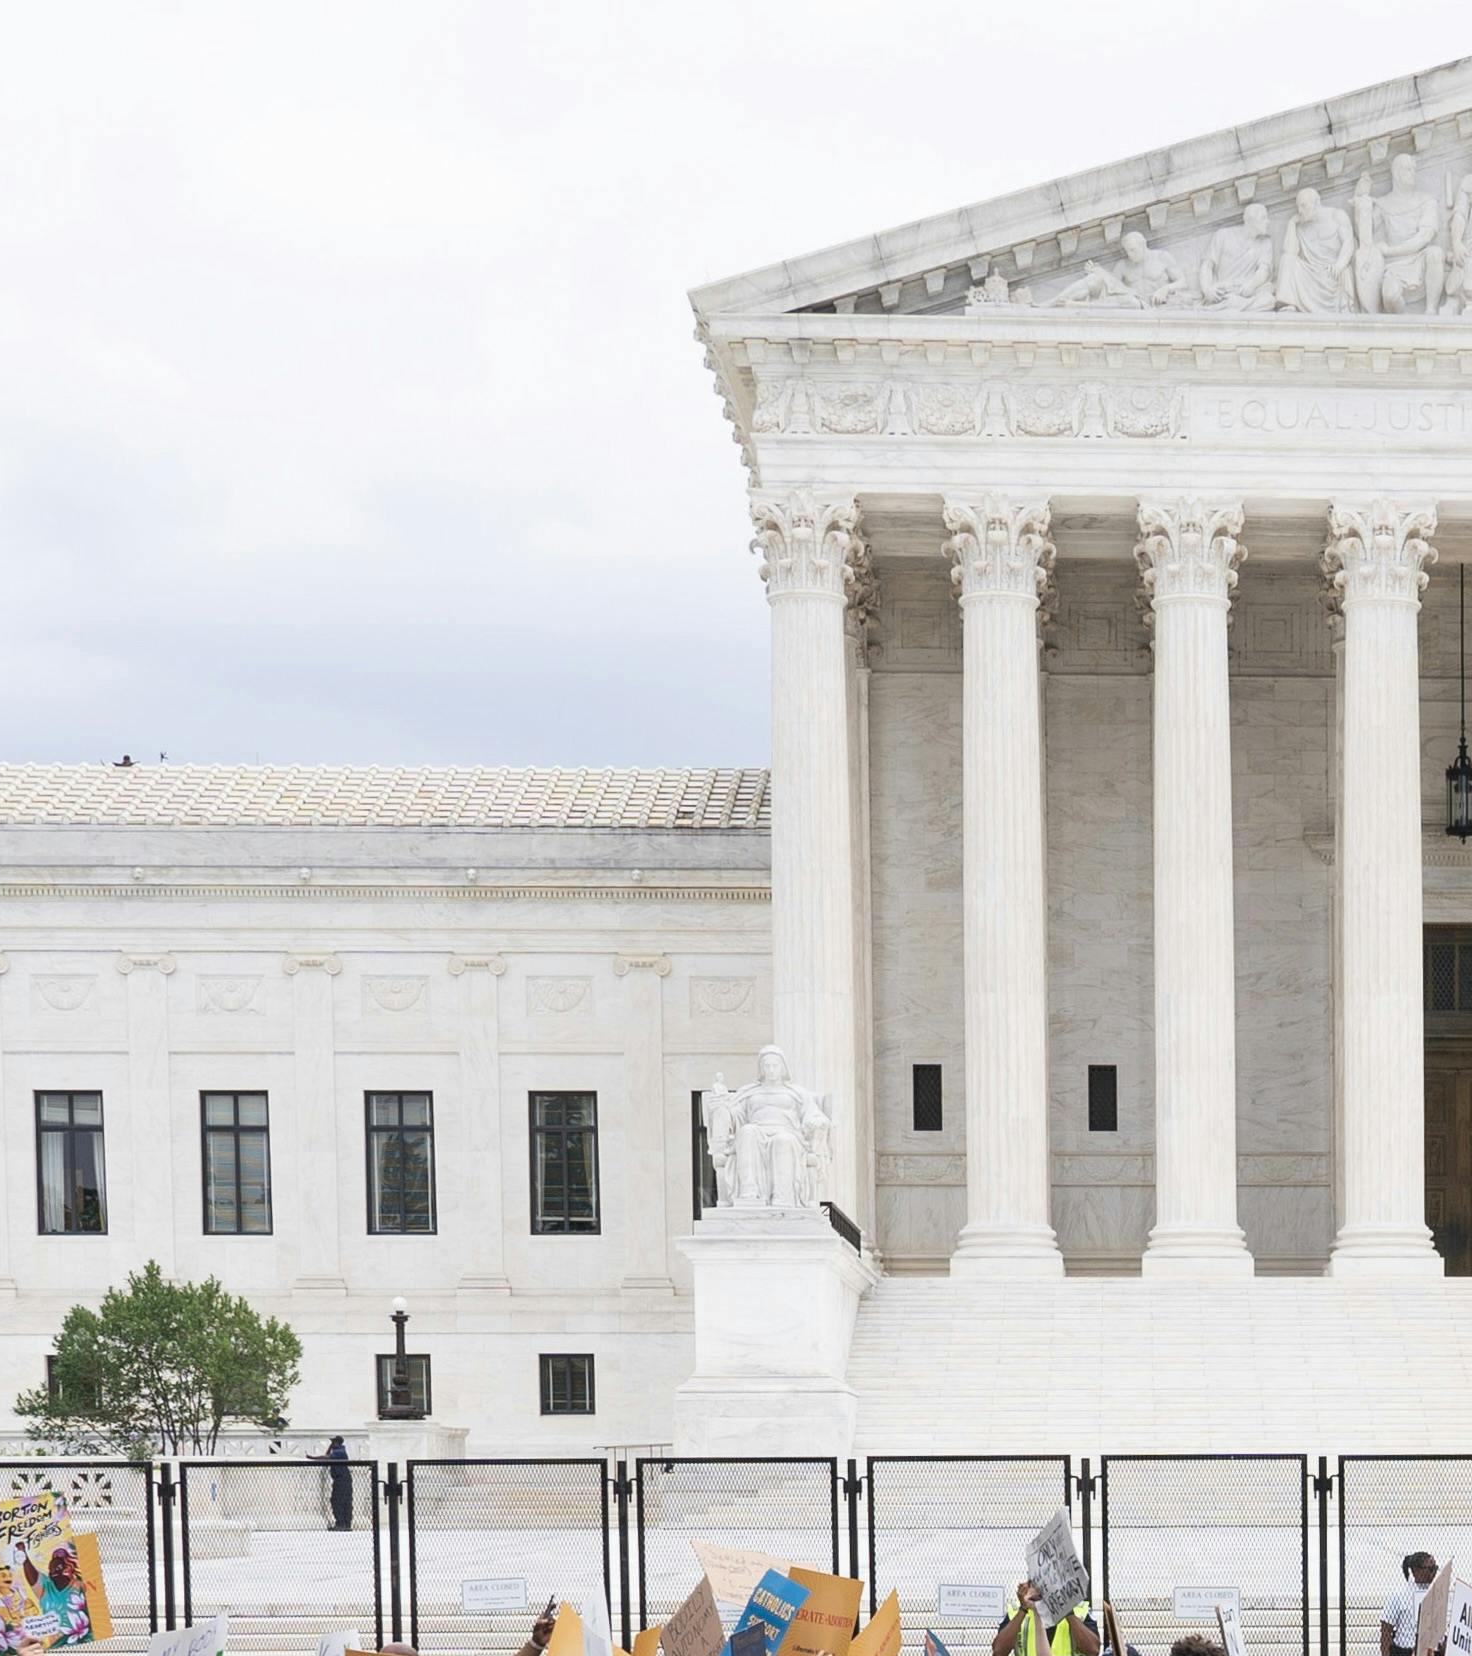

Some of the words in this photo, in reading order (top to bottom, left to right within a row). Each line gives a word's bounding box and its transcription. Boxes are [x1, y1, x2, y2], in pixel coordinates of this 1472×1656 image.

[1216, 400, 1352, 431] EQUAL
[752, 1588, 796, 1622] CATHOLICS
[796, 1609, 824, 1624] ERATE
